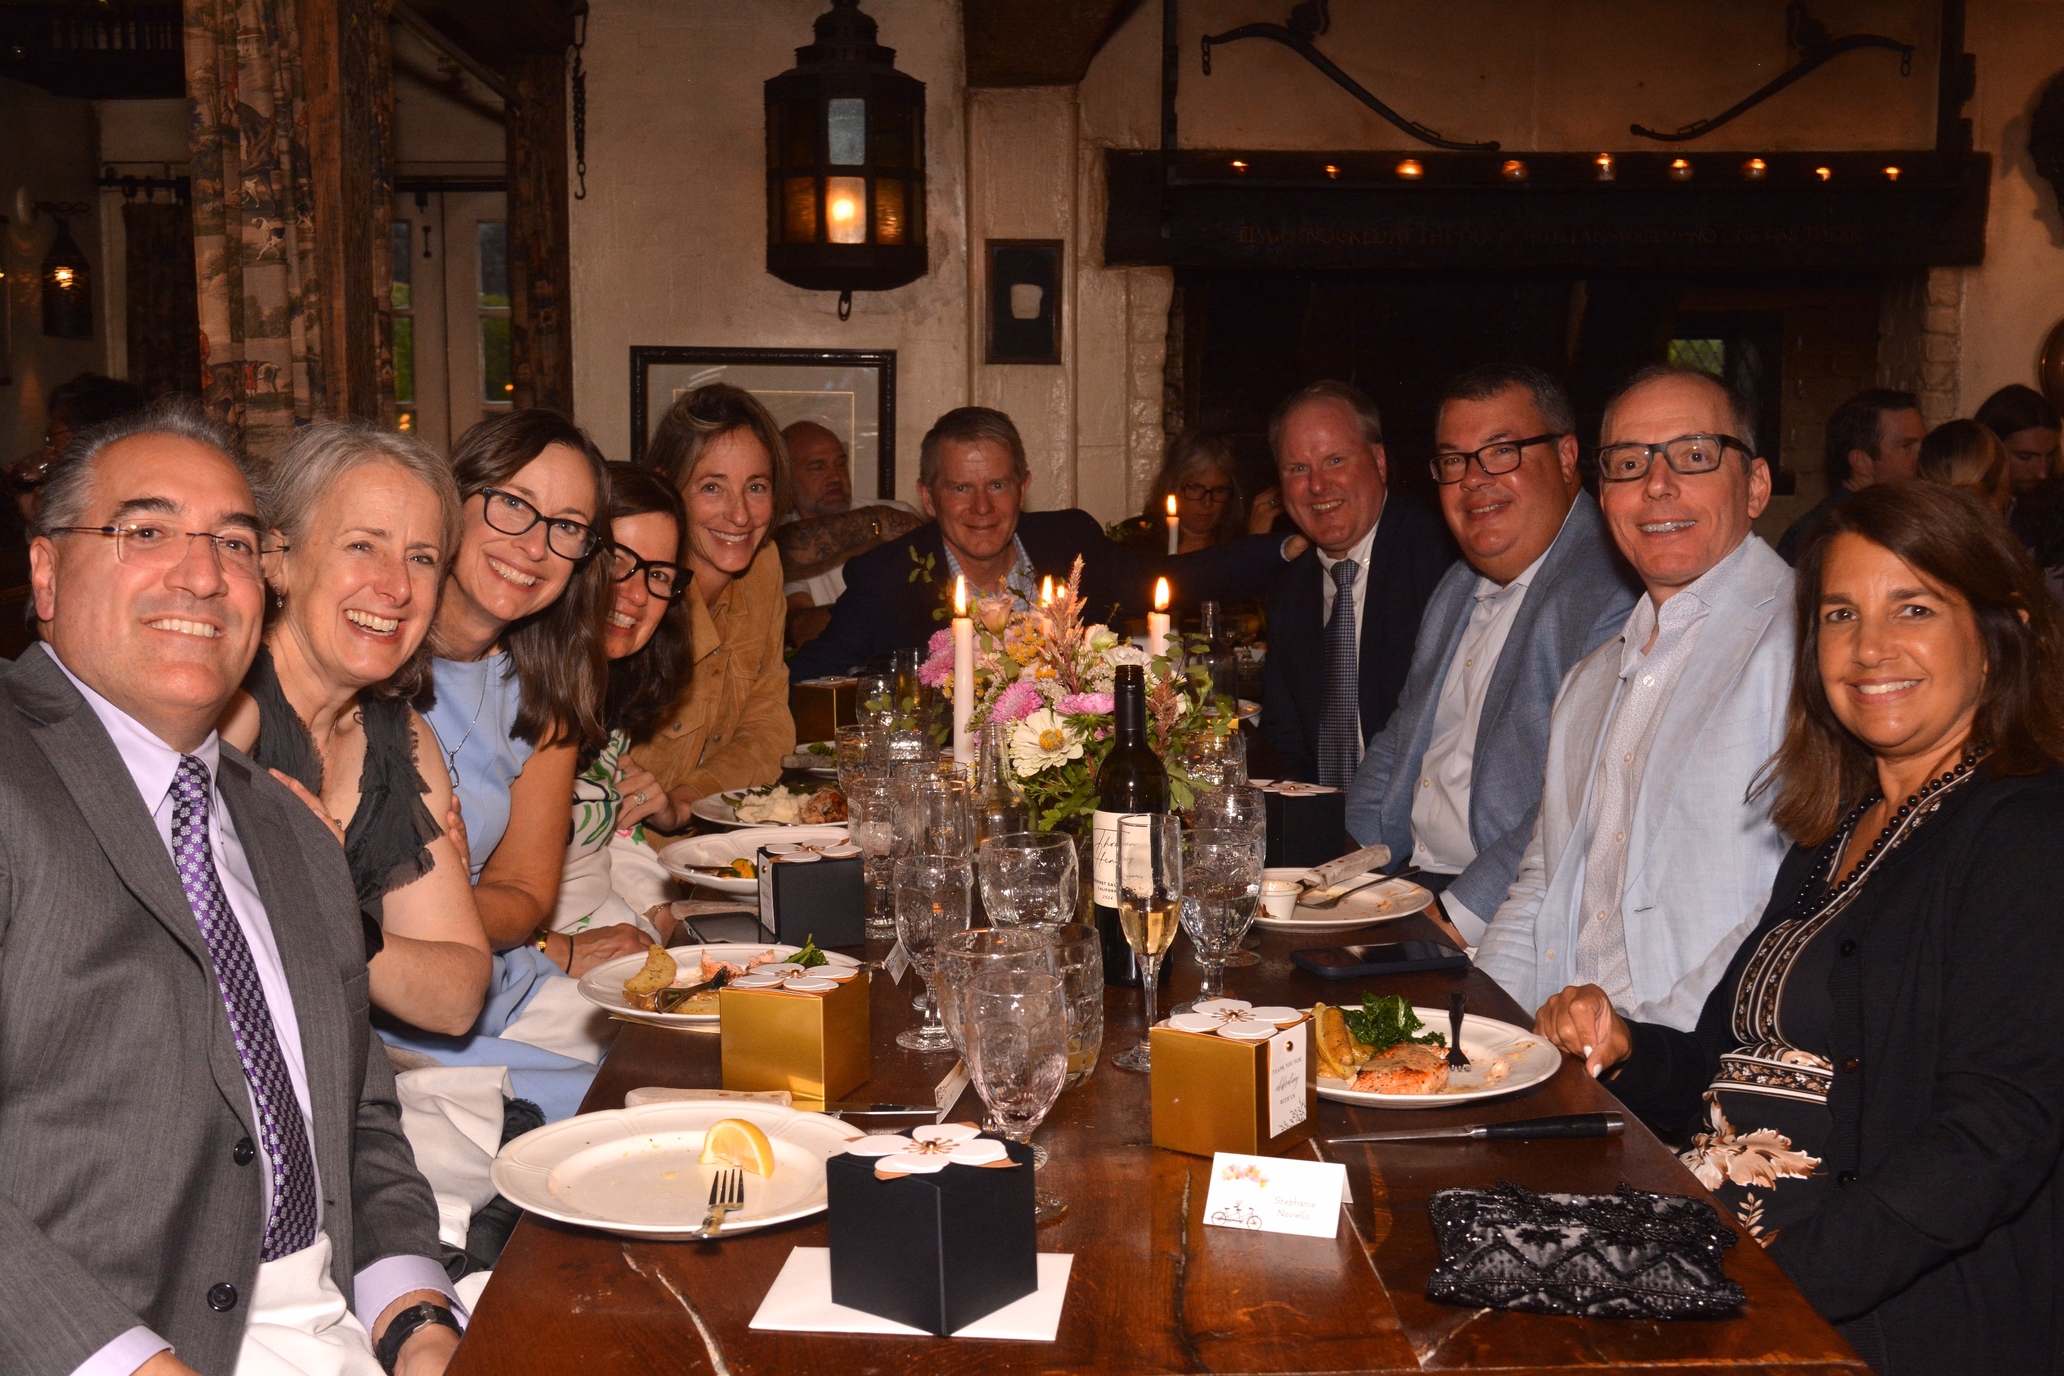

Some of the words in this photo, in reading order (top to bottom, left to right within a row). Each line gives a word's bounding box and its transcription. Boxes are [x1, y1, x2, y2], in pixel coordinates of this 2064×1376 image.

[1291, 226, 1387, 246] KNOCKED
[1272, 1065, 1285, 1075] THANK
[1294, 1056, 1302, 1065] FOR
[1280, 1096, 1290, 1105] WITH
[1274, 1196, 1317, 1209] Stephanie
[1277, 1209, 1310, 1220] Noviello
